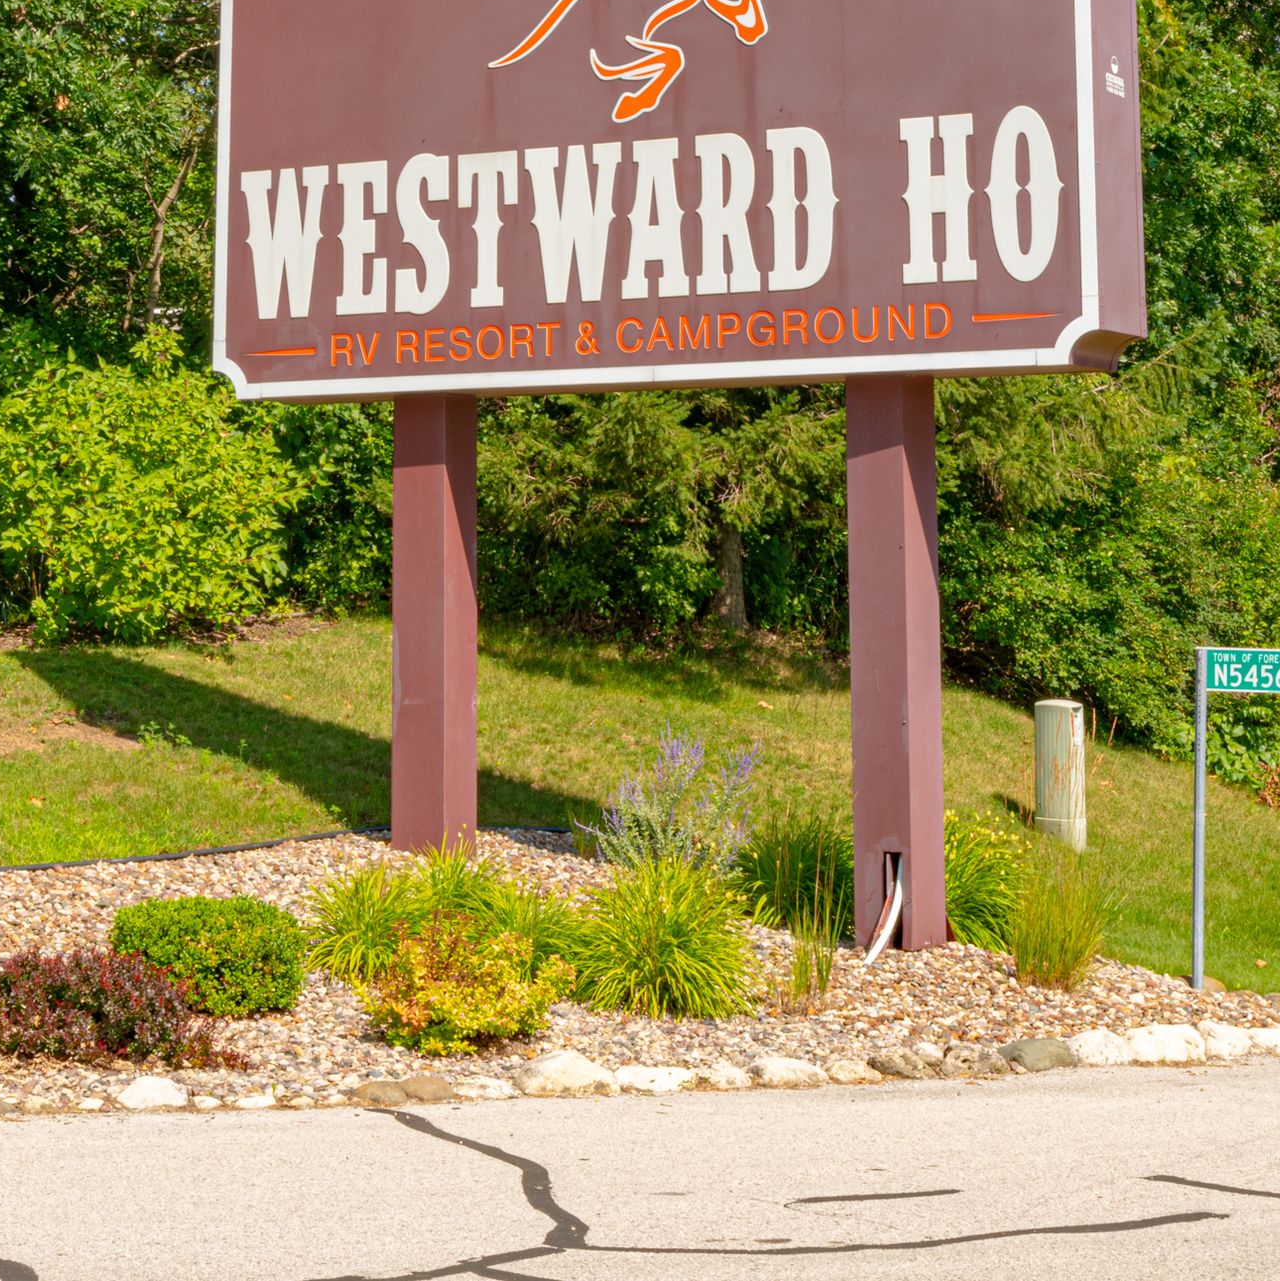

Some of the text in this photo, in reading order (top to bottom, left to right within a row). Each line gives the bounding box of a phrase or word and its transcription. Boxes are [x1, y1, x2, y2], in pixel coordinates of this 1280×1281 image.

[240, 105, 1065, 321] WESTWARD HO
[330, 303, 953, 367] RV RESORT & CAMPGROUND
[1213, 652, 1236, 663] TOWN
[1242, 653, 1252, 663] OF
